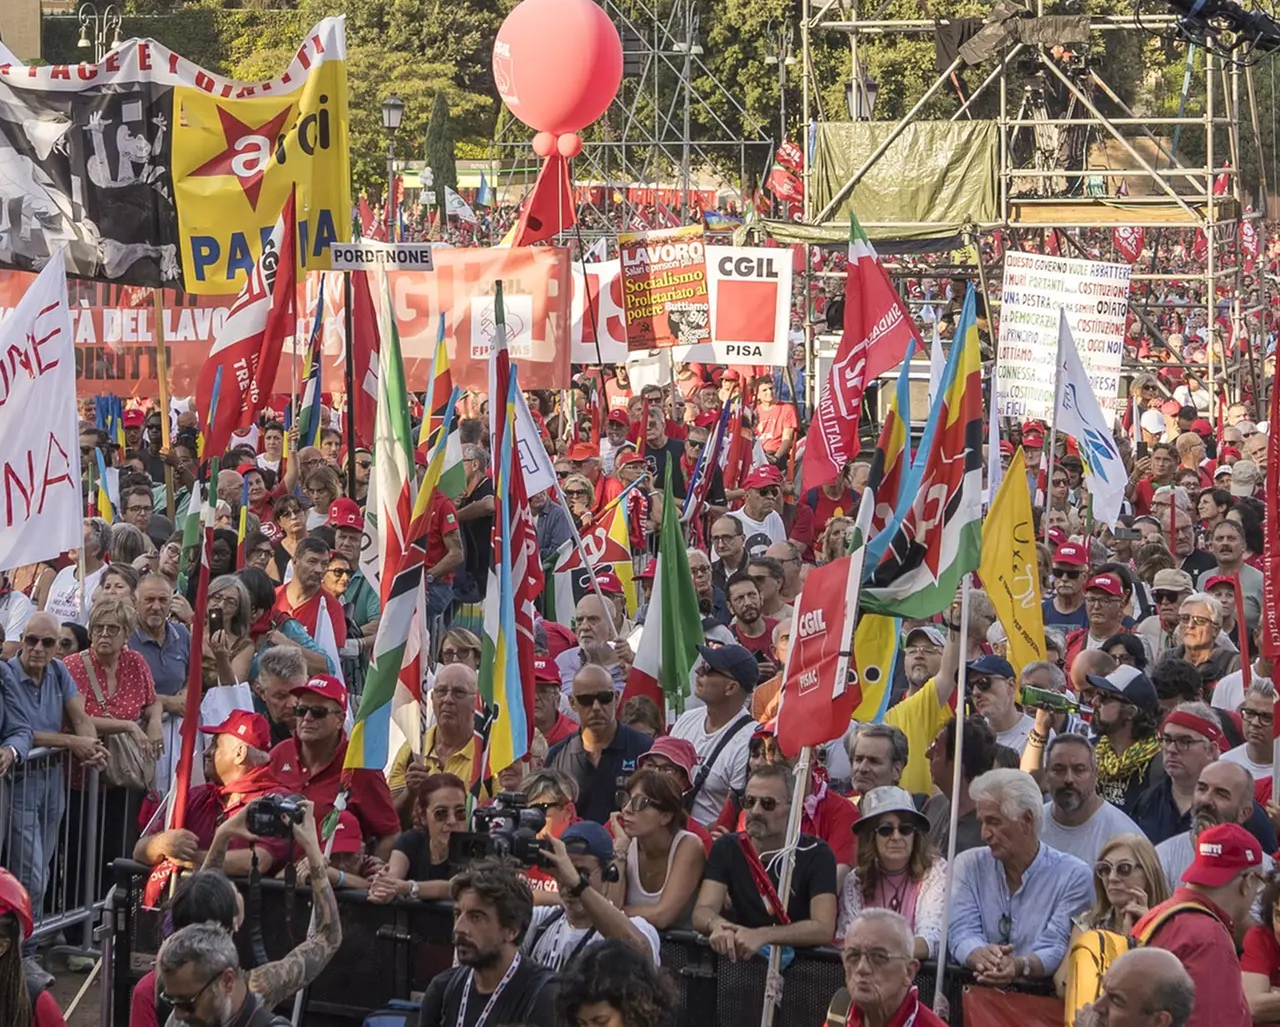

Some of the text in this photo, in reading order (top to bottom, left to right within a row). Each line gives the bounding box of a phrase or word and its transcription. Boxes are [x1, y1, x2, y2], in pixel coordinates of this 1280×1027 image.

[623, 242, 704, 266] LAVORO
[625, 265, 645, 276] Salari
[651, 261, 680, 273] pensioni
[718, 256, 779, 278] CGIL
[1006, 255, 1034, 269] QUESTO
[1034, 259, 1068, 274] GOVERNO
[1090, 264, 1131, 280] ABBATTERE
[626, 271, 703, 293] Socialismo
[626, 280, 707, 308] Proletariato al
[1003, 291, 1020, 304] UNA
[1022, 293, 1051, 309] DESTRA
[627, 301, 709, 324] potere Buttiamo
[1009, 310, 1058, 329] DEMOCRAZIA
[103, 309, 152, 343] DEL
[726, 345, 762, 357] PISA
[1087, 339, 1105, 353] OGGI
[1106, 341, 1122, 354] NOI
[998, 364, 1036, 381] CONNESSA
[1006, 400, 1027, 416] FIGLI
[799, 608, 827, 638] CGIL
[800, 669, 818, 690] FISAC
